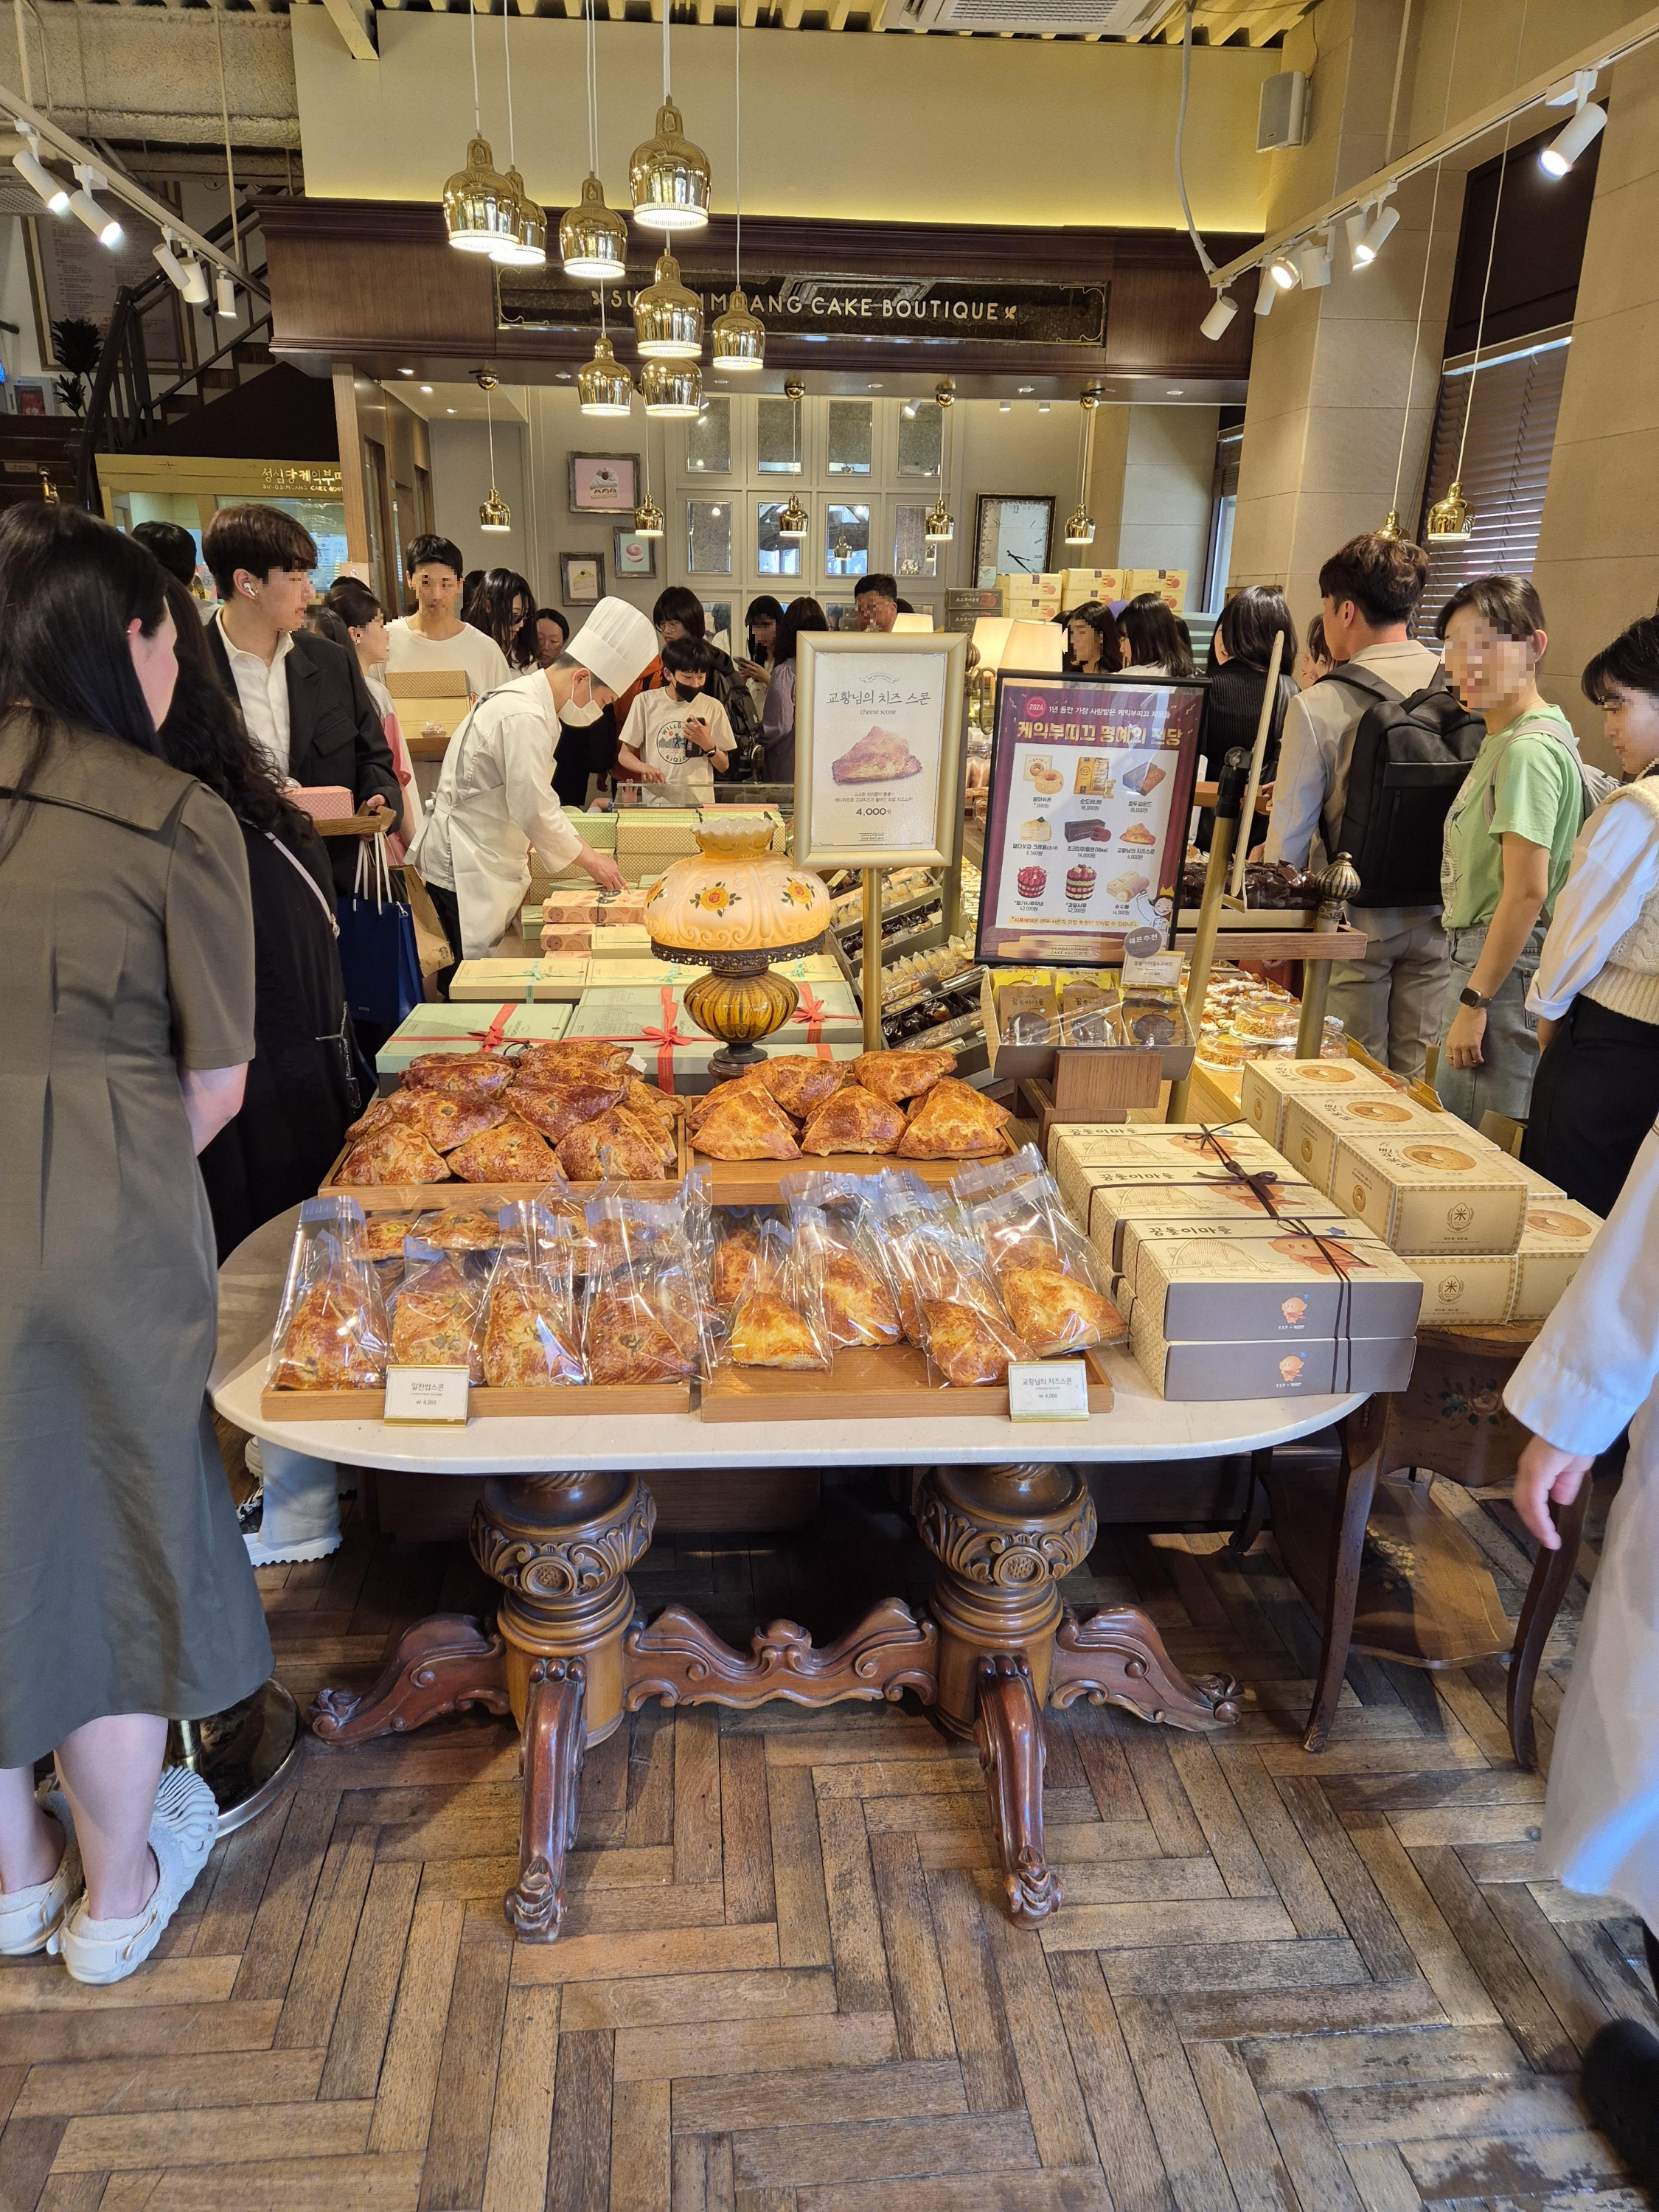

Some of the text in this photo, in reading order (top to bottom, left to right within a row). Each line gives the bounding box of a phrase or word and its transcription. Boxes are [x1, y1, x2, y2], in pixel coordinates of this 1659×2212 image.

[811, 296, 872, 317] CAKE
[883, 299, 998, 320] BOUTIQUE
[826, 689, 931, 705] 교황님의 치즈 스콘
[1060, 706, 1073, 714] 동안
[1075, 706, 1088, 715] 가장
[1091, 707, 1116, 716] 사랑받은
[1118, 709, 1149, 717] 케익부띠끄
[1016, 720, 1183, 746] 케익부띠끄 명예의 전당
[1068, 1127, 1138, 1135] 꿈돌이마들
[1099, 1172, 1175, 1181] 꿈돌이마들
[1149, 1225, 1232, 1237] 꿈돌이마들
[1022, 1377, 1072, 1385] 교황님의 치즈스콘
